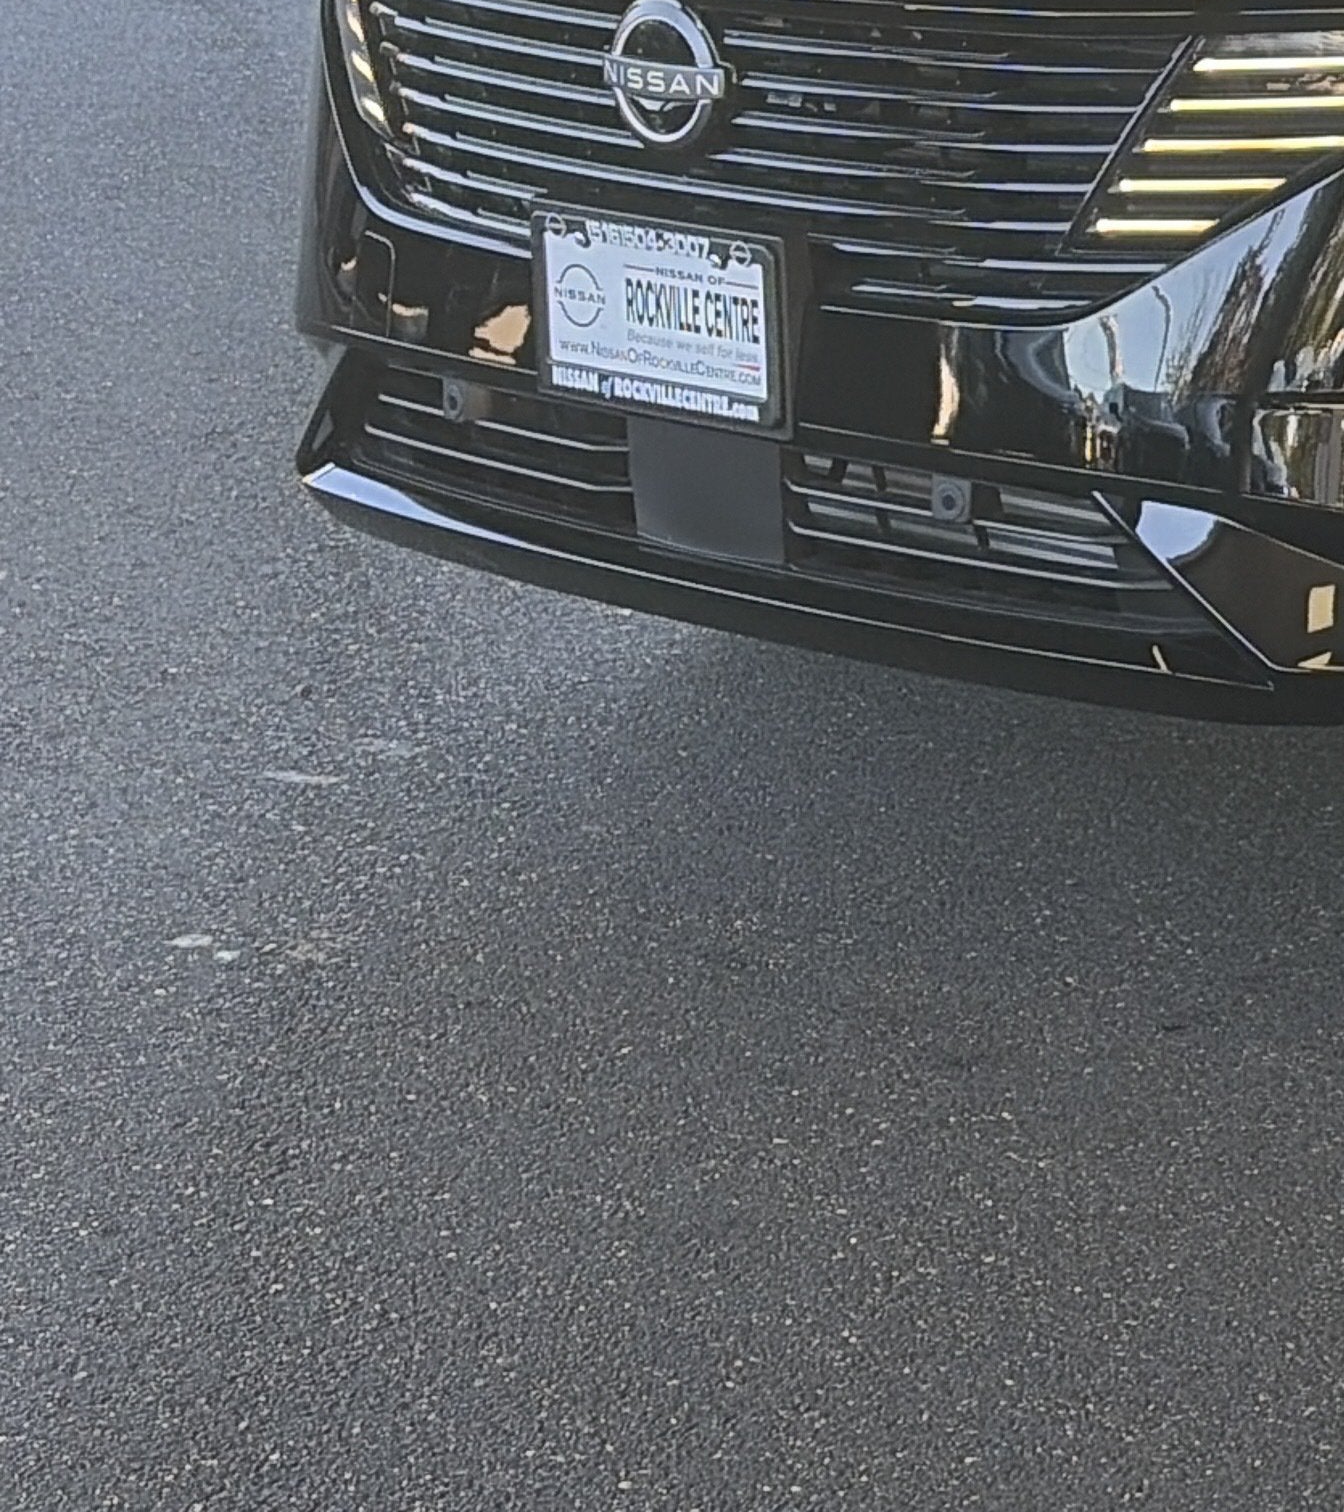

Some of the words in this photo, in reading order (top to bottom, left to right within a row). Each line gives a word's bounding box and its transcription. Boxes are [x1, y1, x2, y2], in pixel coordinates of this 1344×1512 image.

[604, 59, 719, 96] NISSAN
[655, 266, 703, 283] NISSAN
[707, 274, 726, 286] OF
[554, 286, 606, 305] NISSAN
[625, 277, 701, 334] ROCKVILLE
[704, 289, 760, 345] CENTRE
[627, 328, 674, 349] Because
[677, 340, 692, 352] we
[718, 345, 733, 359] for
[552, 364, 600, 394] NISSAN
